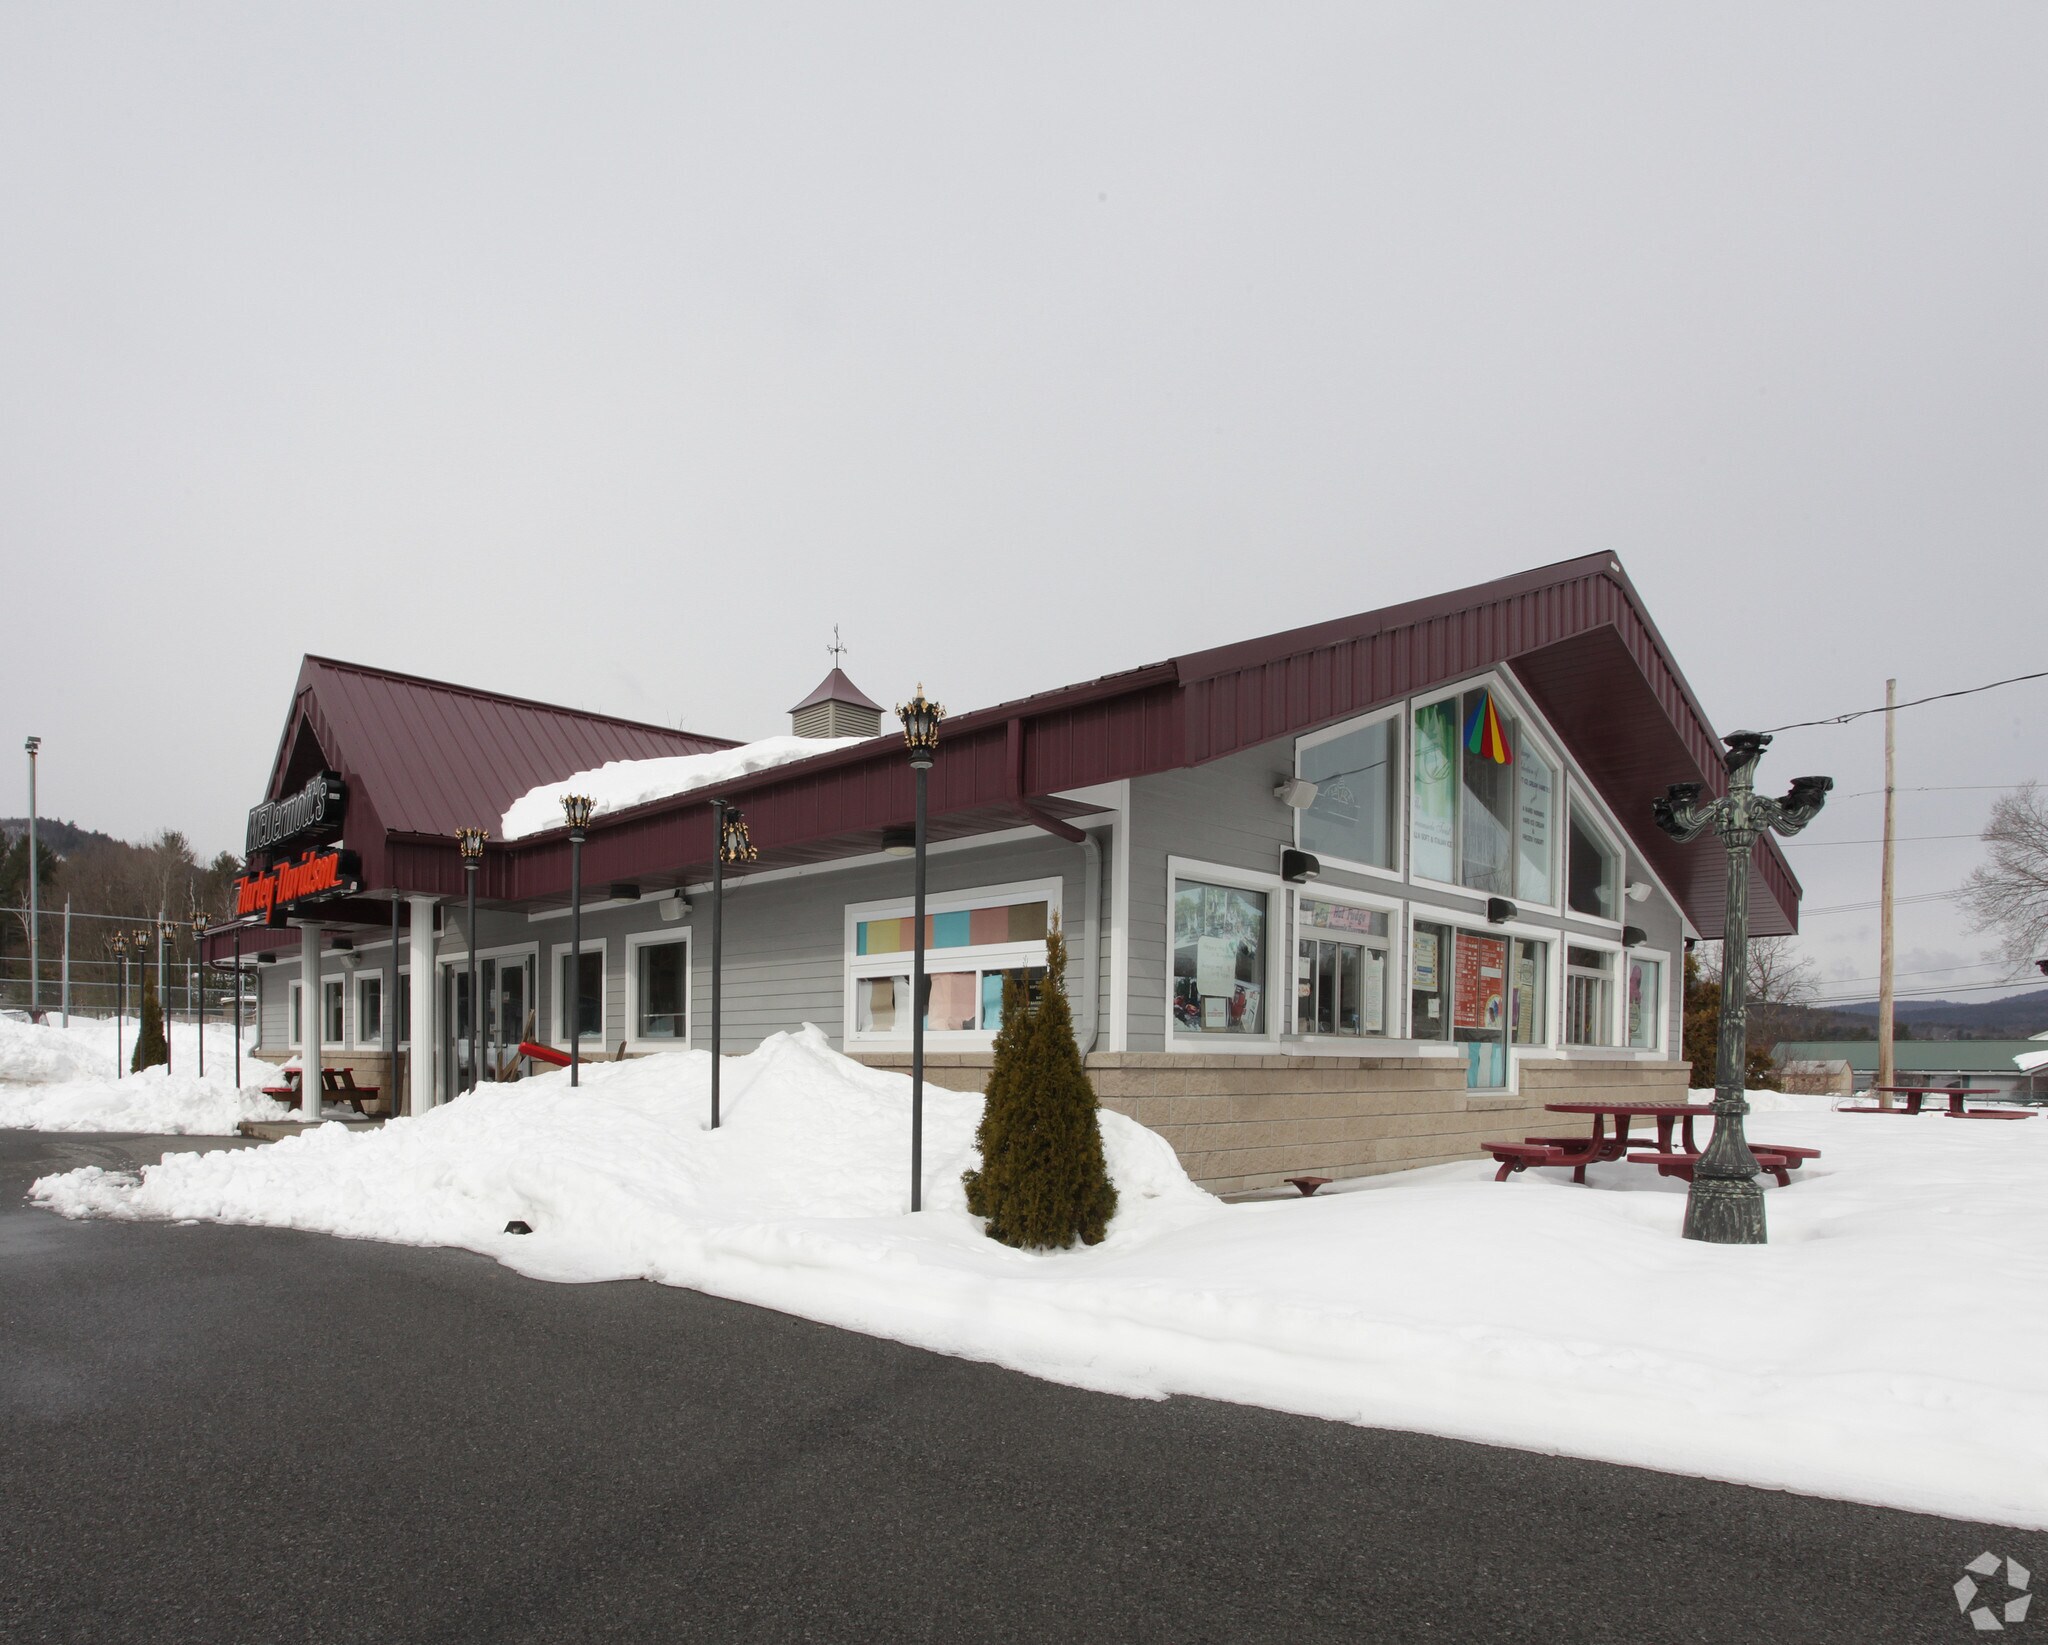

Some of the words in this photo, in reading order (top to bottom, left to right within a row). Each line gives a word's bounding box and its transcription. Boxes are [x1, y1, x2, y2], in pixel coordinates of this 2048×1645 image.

[246, 776, 328, 853] McDermott's
[234, 850, 344, 924] Harley-Davidson
[1333, 905, 1345, 919] Hot
[1347, 908, 1367, 926] Fudge
